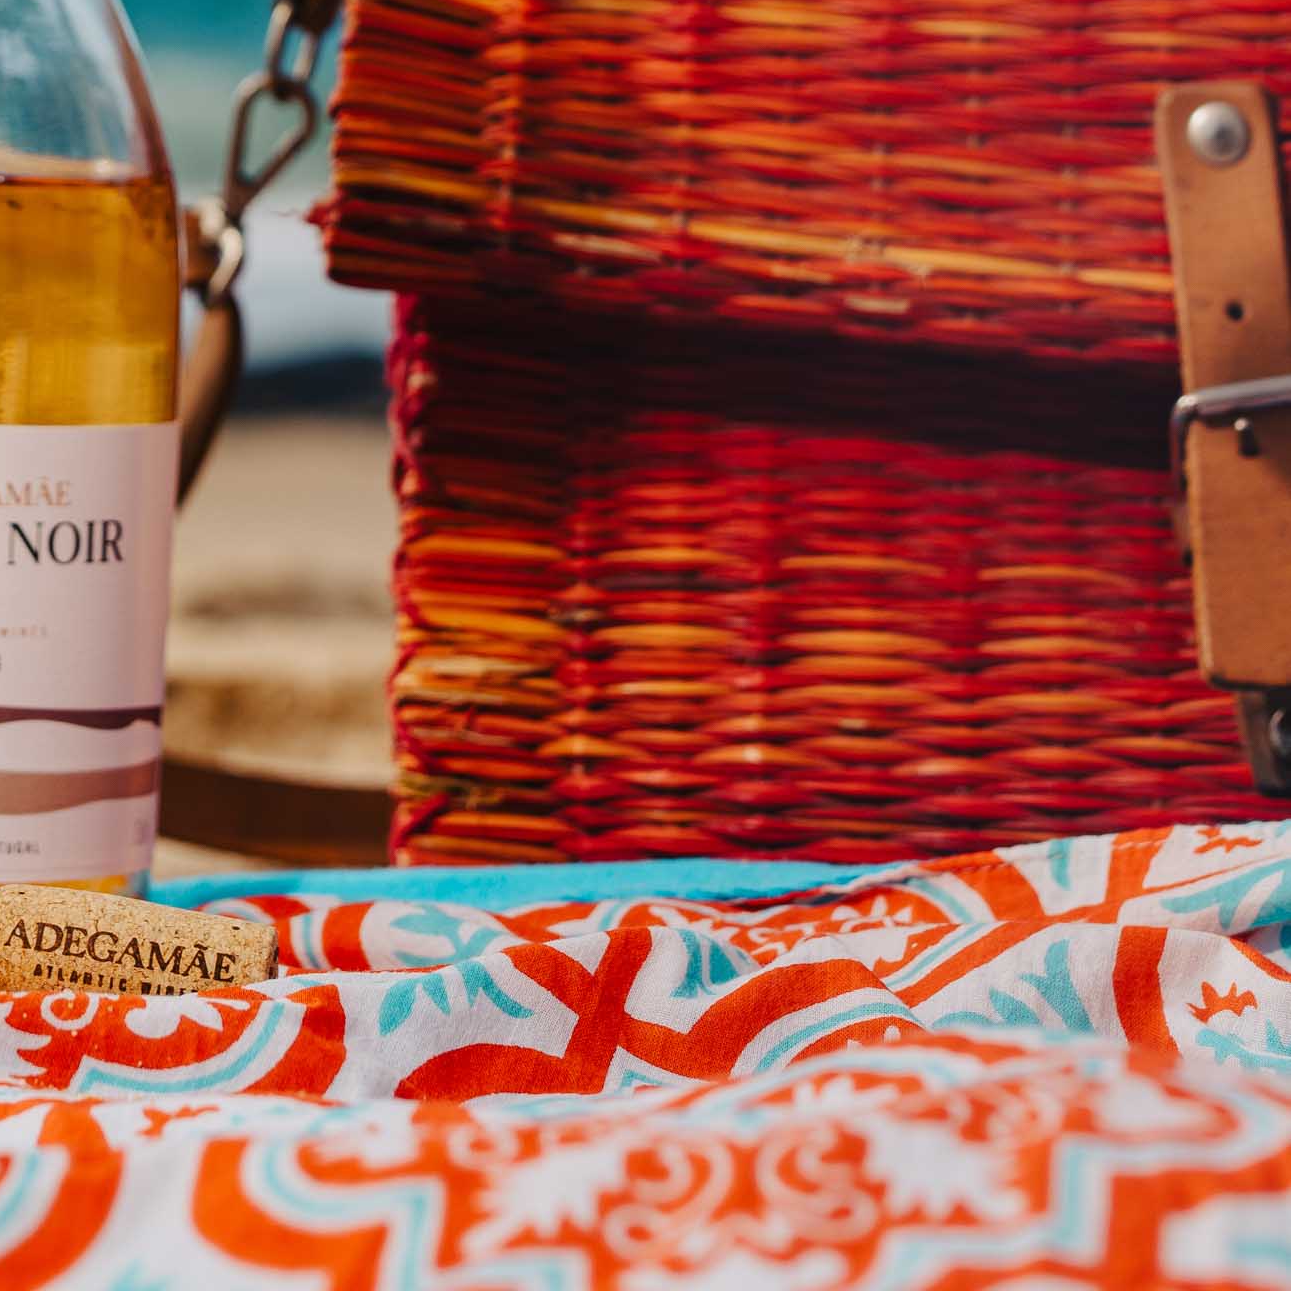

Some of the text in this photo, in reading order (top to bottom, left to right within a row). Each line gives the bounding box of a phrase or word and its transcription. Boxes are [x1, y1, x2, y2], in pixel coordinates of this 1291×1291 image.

[6, 519, 125, 567] NOIR
[3, 918, 237, 984] ADEGAMÃE
[33, 963, 127, 993] ATLANTIC
